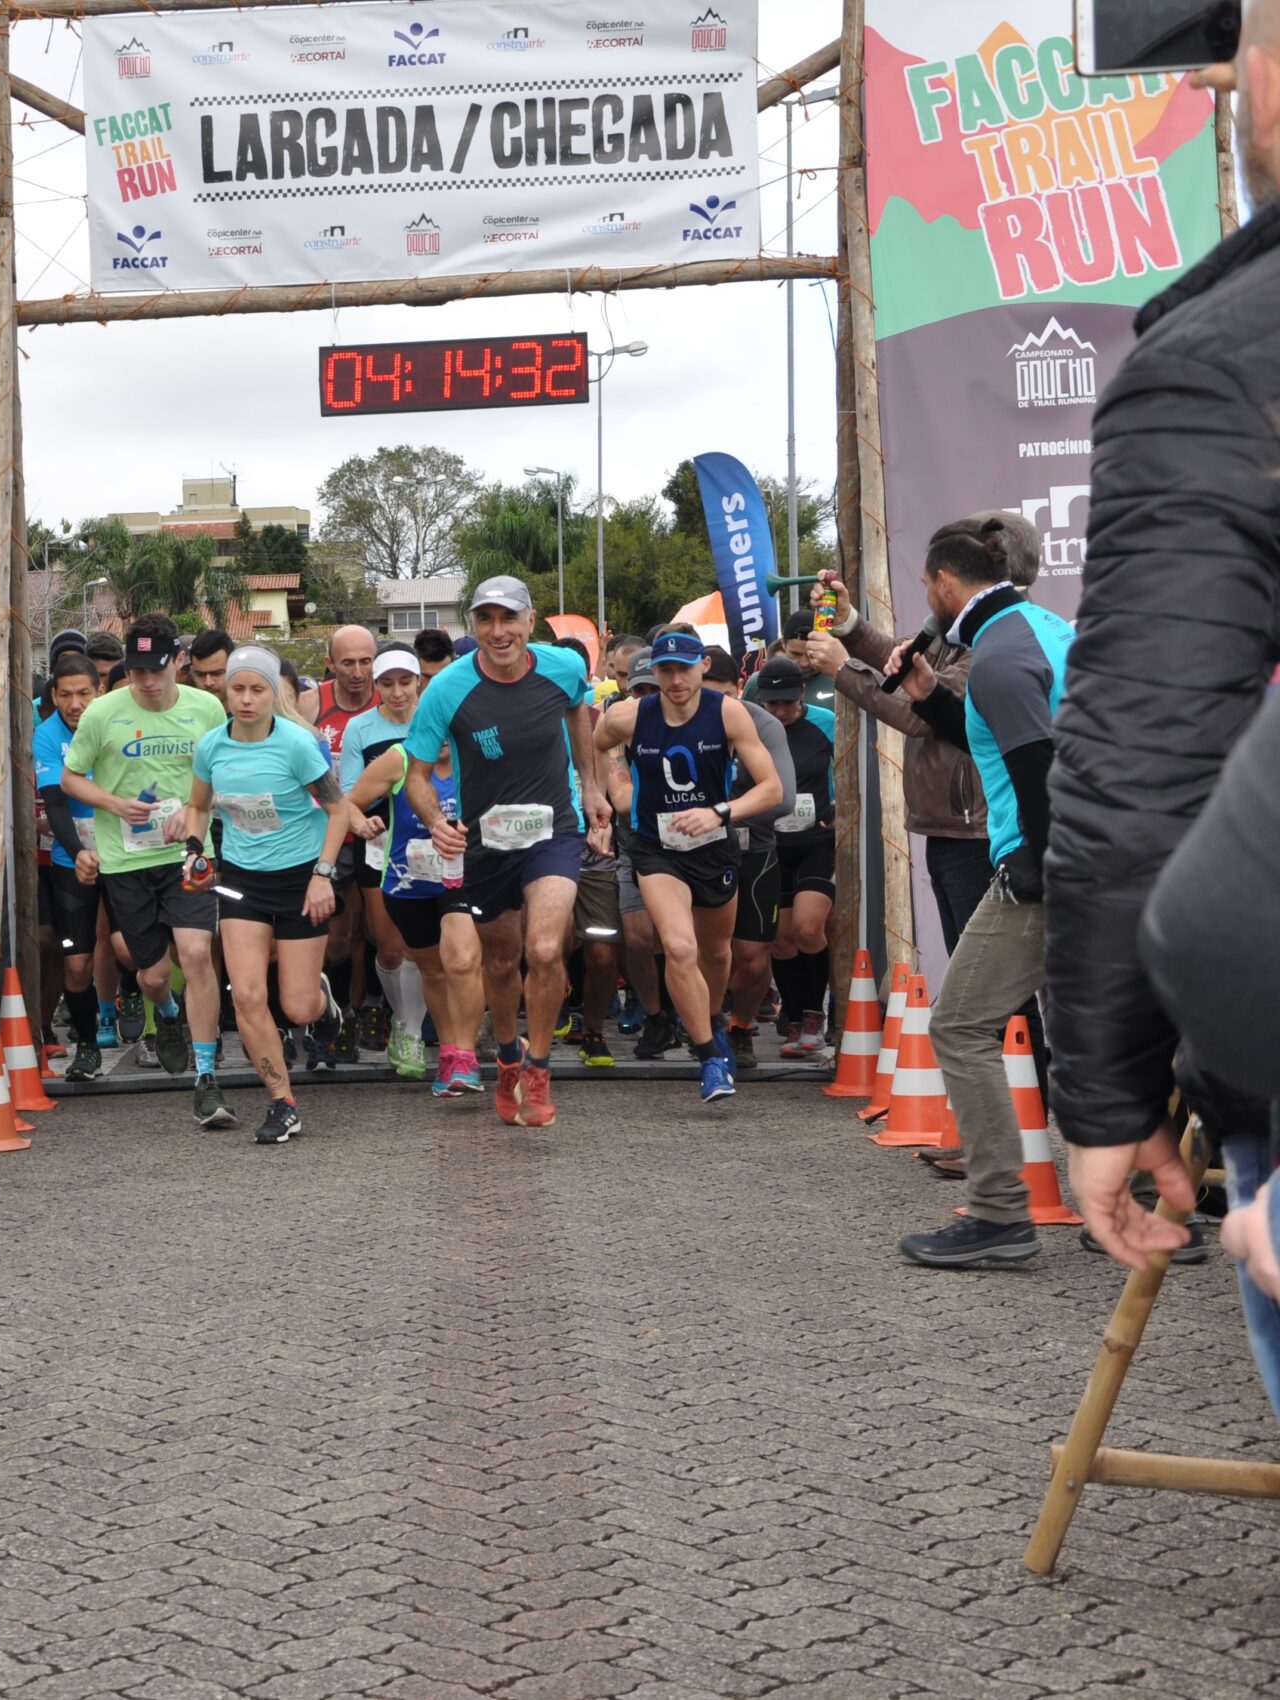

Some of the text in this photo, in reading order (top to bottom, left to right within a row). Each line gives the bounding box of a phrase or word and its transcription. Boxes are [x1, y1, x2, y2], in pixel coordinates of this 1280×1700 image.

[487, 38, 545, 50] construarte
[388, 53, 446, 67] FACCAT
[93, 102, 172, 146] FACCAT
[112, 136, 171, 169] TRAIL
[962, 108, 1159, 202] TRAIL
[117, 159, 177, 203] RUN
[683, 226, 742, 241] FACCAT
[978, 173, 1182, 299] RUN
[304, 235, 362, 249] construarte
[112, 256, 168, 269] FACCAT
[1015, 349, 1074, 359] CAMPEONATO
[1016, 357, 1096, 401] GAÚCHO
[1033, 399, 1057, 408] TRAIL
[1058, 396, 1097, 406] RUNNING
[722, 492, 766, 653] runners
[665, 792, 705, 804] LUCAS
[504, 819, 543, 832] 7068
